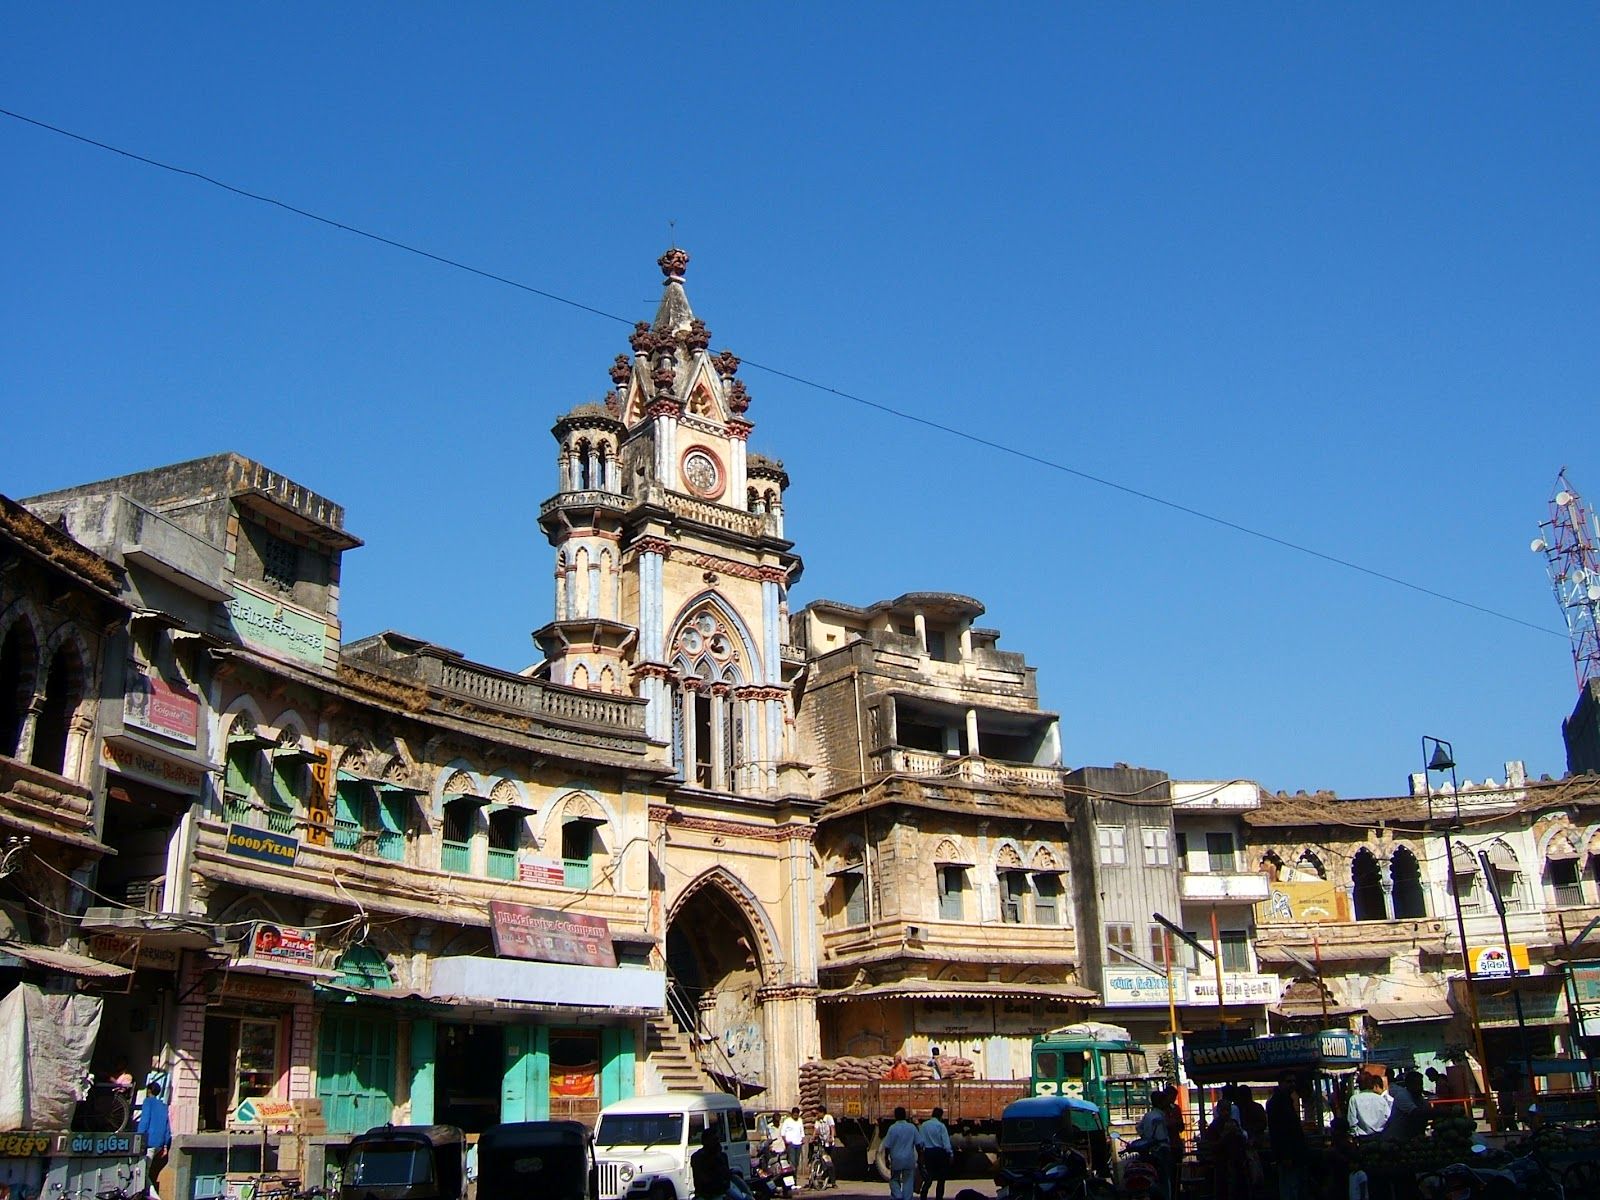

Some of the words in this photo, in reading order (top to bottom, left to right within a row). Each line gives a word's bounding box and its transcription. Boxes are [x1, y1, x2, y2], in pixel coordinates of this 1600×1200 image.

[154, 704, 180, 718] Colgate
[563, 921, 606, 939] Company
[96, 1134, 129, 1155] હાઉસ
